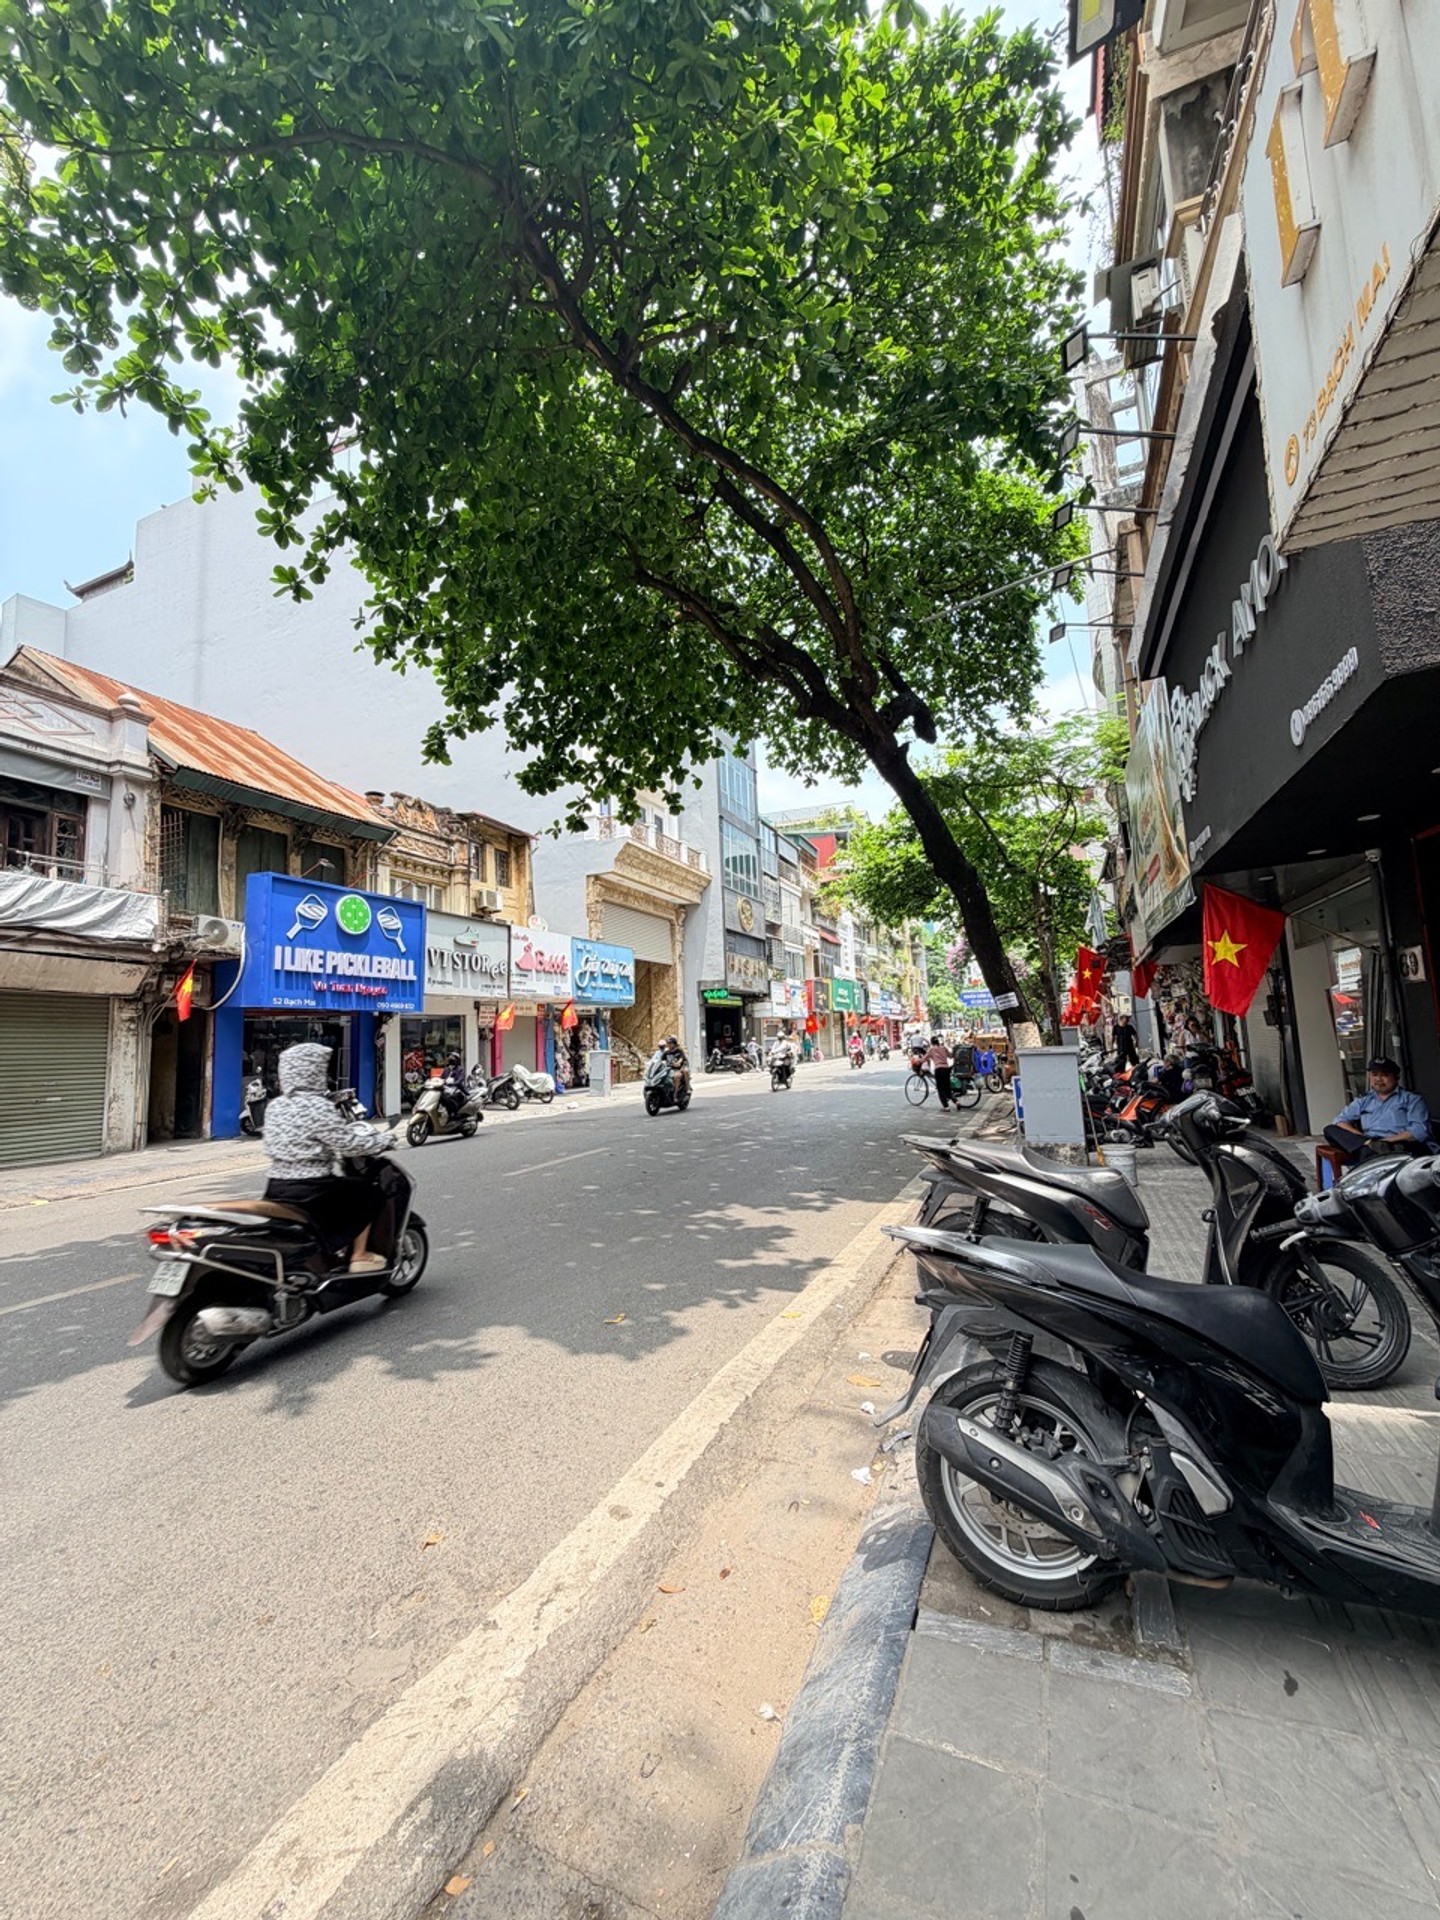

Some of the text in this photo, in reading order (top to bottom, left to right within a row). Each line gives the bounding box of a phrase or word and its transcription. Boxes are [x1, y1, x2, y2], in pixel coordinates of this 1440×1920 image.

[273, 945, 418, 981] I LIKE PICKLEBALL
